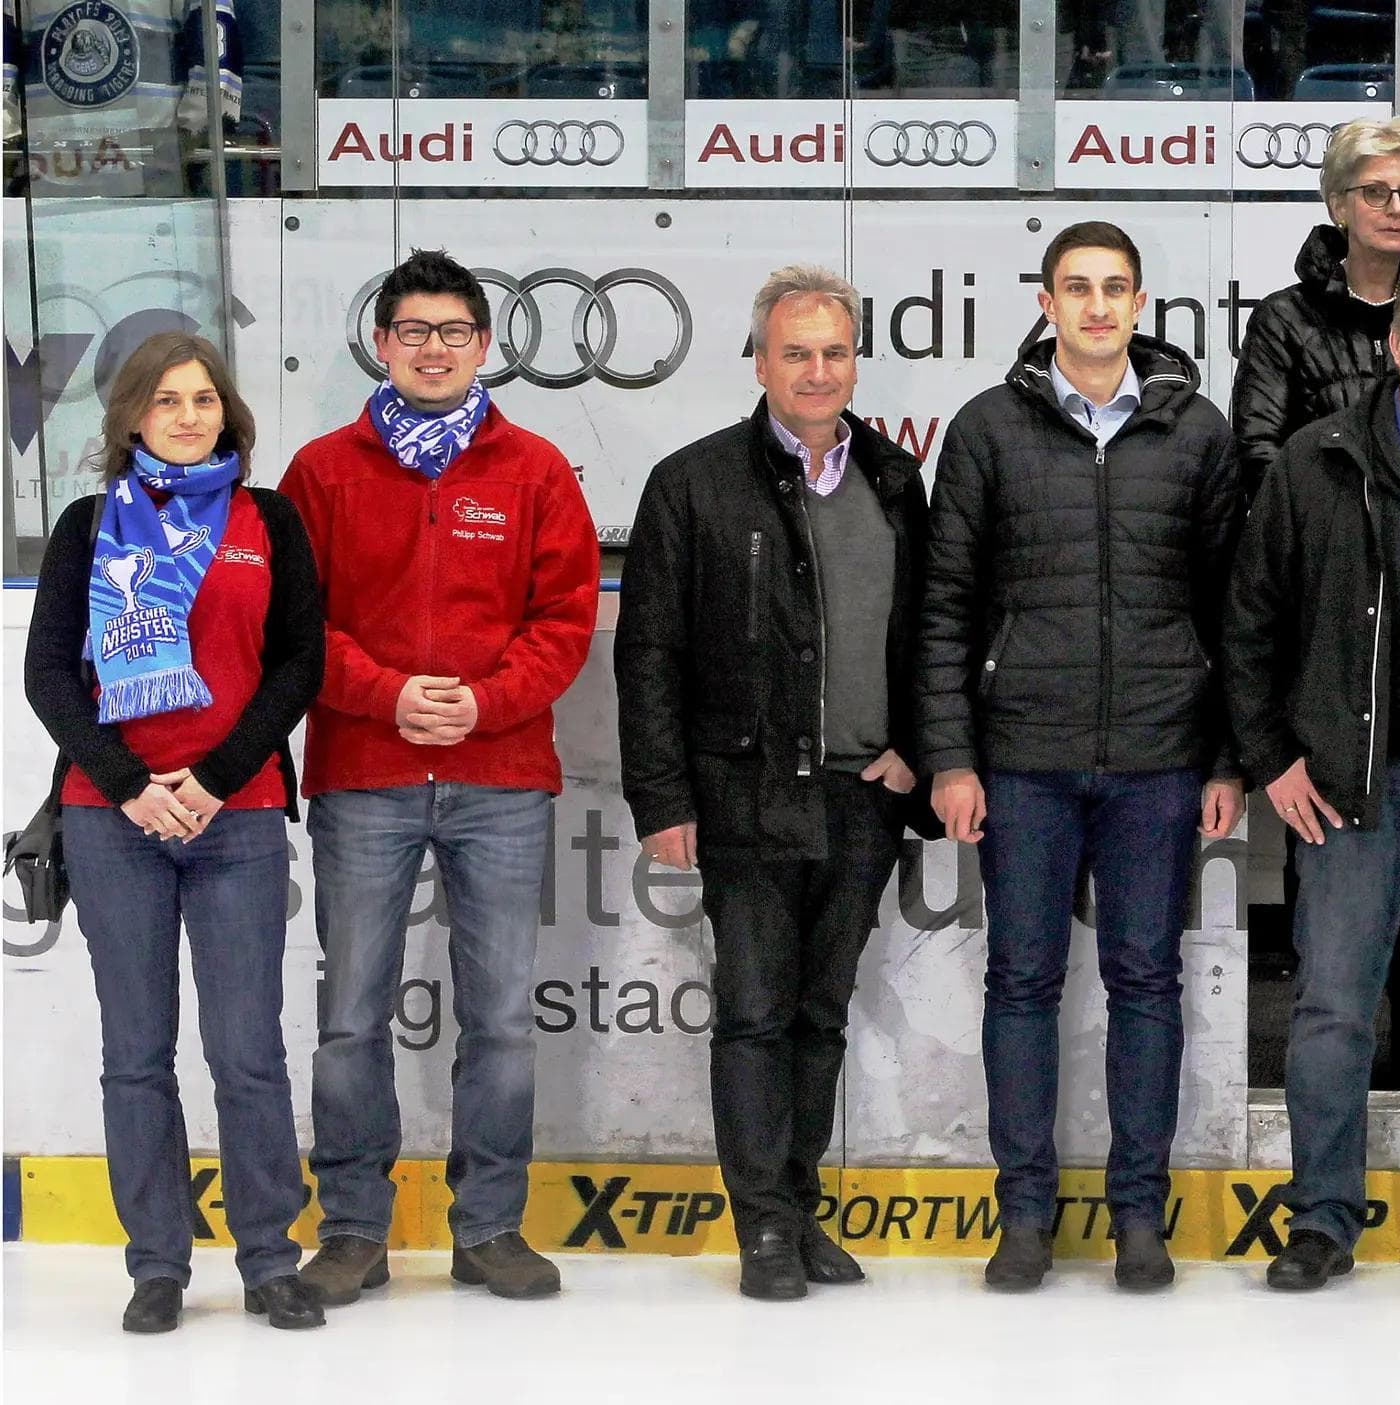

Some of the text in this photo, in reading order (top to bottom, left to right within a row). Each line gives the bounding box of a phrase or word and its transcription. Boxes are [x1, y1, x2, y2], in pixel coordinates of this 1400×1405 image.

[327, 123, 473, 162] Audi
[699, 124, 845, 164] Audi
[1068, 125, 1215, 165] Audi
[465, 509, 506, 522] Schwab
[477, 531, 505, 542] Schwab
[225, 551, 264, 564] Schwab
[106, 606, 168, 631] DEUTSCHER
[102, 616, 177, 656] MEISTER
[125, 642, 154, 661] 2014
